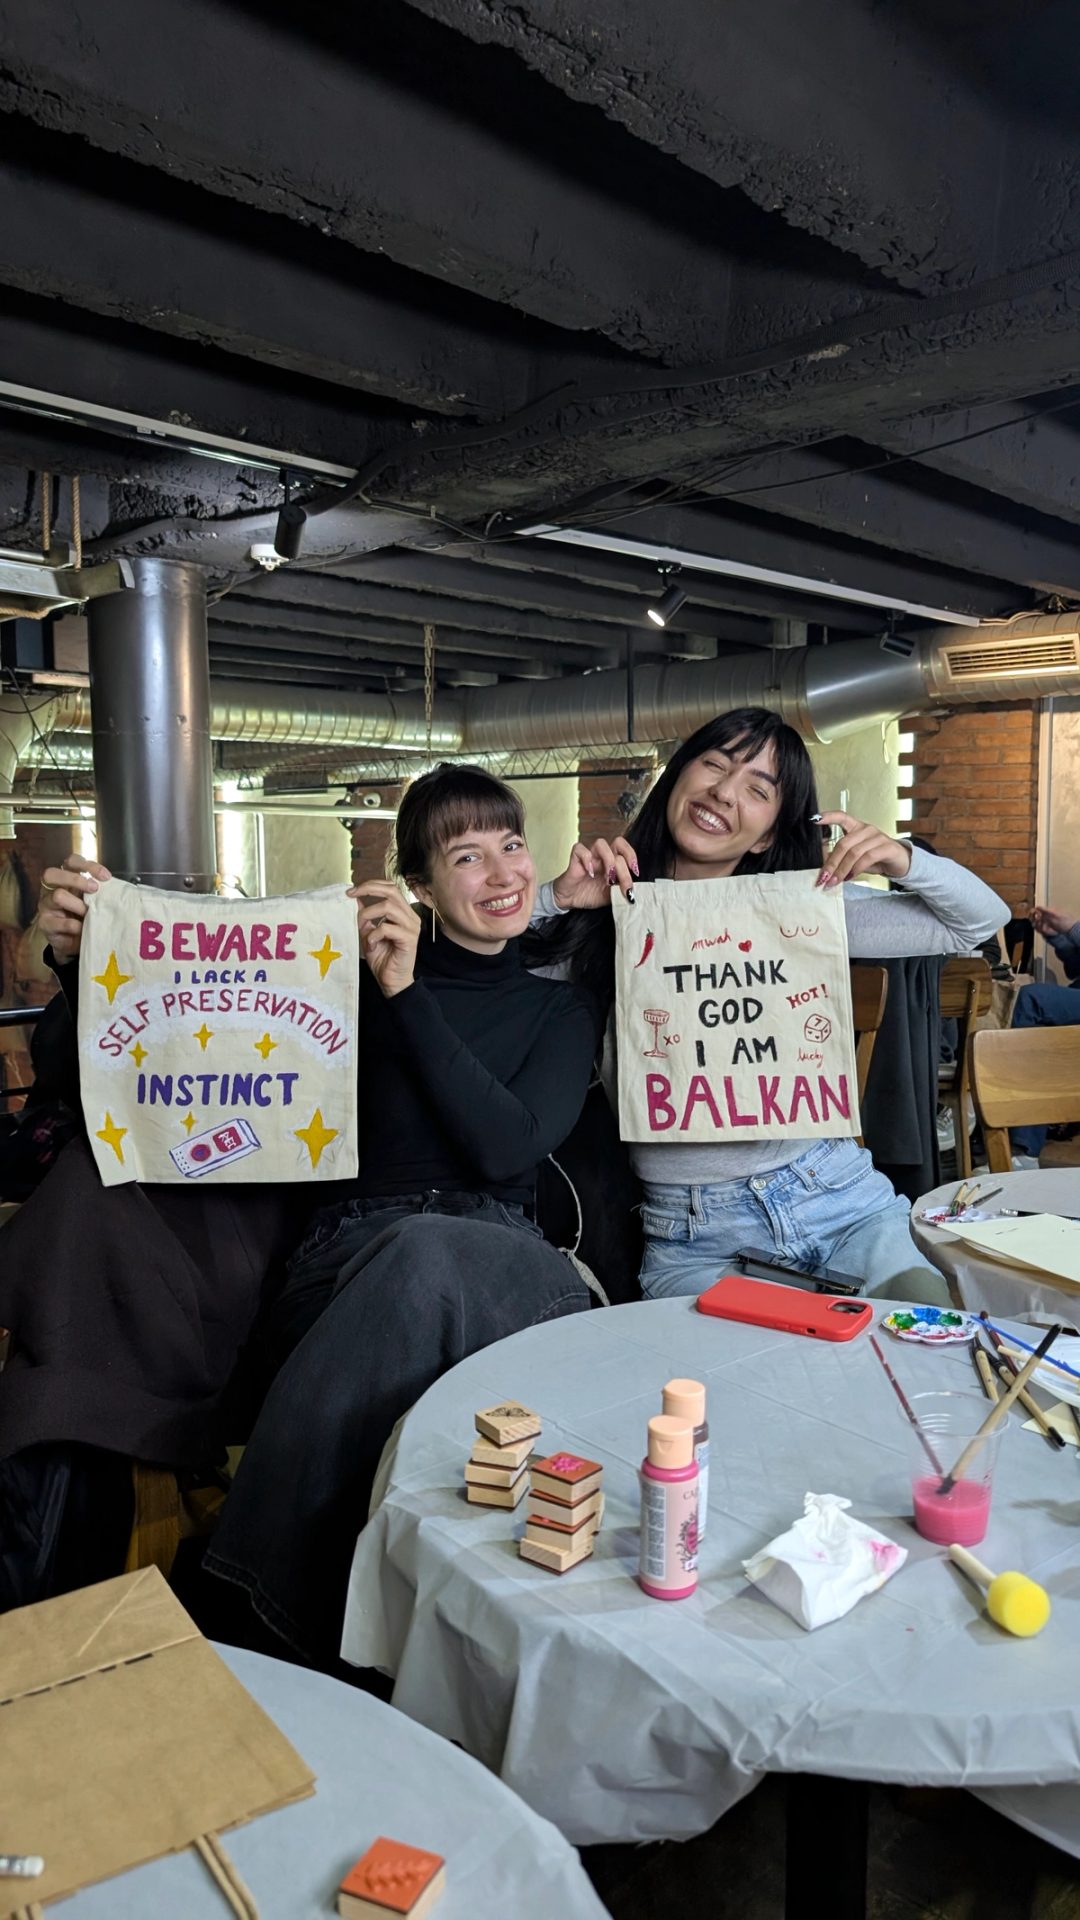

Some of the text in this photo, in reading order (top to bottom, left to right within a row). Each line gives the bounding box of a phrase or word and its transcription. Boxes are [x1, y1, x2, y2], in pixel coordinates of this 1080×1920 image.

[139, 920, 298, 962] BEWARE
[174, 969, 267, 984] I LACK A
[663, 959, 788, 993] THANK
[698, 998, 763, 1028] GOD
[786, 984, 828, 1009] HOT!
[99, 988, 348, 1057] SELF PRESERVATION
[696, 1036, 778, 1068] I AM
[137, 1073, 299, 1106] INSTINCT
[646, 1073, 850, 1131] BALKAN
